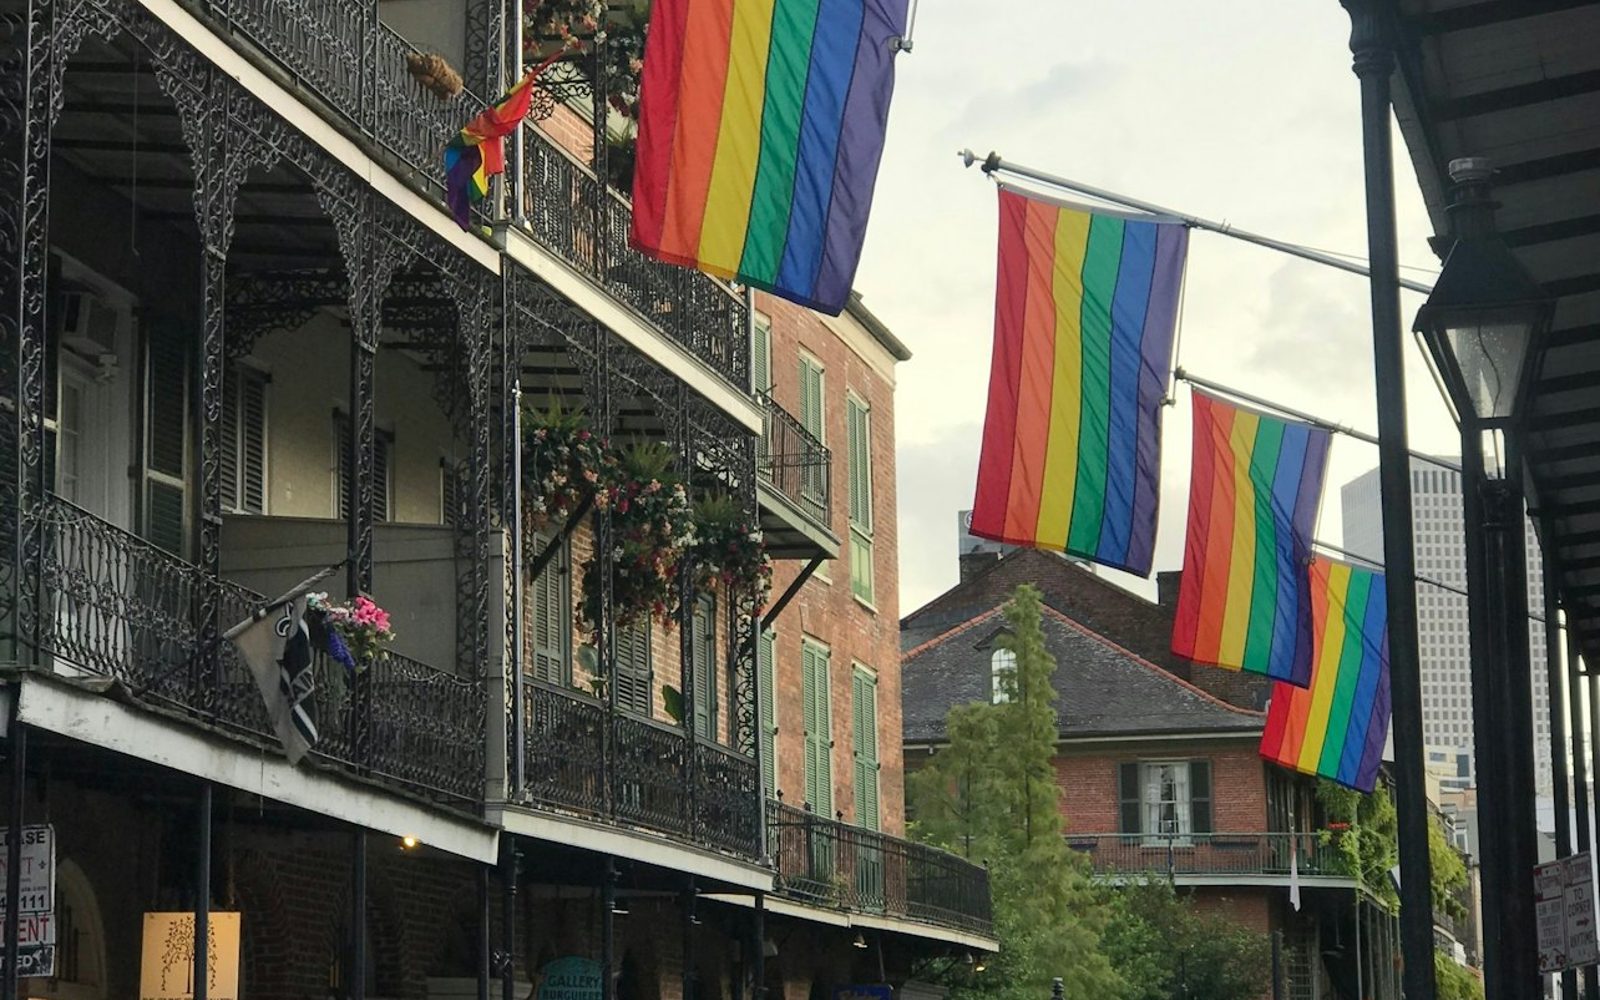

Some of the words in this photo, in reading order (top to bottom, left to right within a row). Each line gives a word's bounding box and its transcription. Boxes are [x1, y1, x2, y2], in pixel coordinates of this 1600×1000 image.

[1574, 887, 1583, 900] TO
[1568, 899, 1591, 917] CORNER
[548, 975, 600, 988] GALLERY
